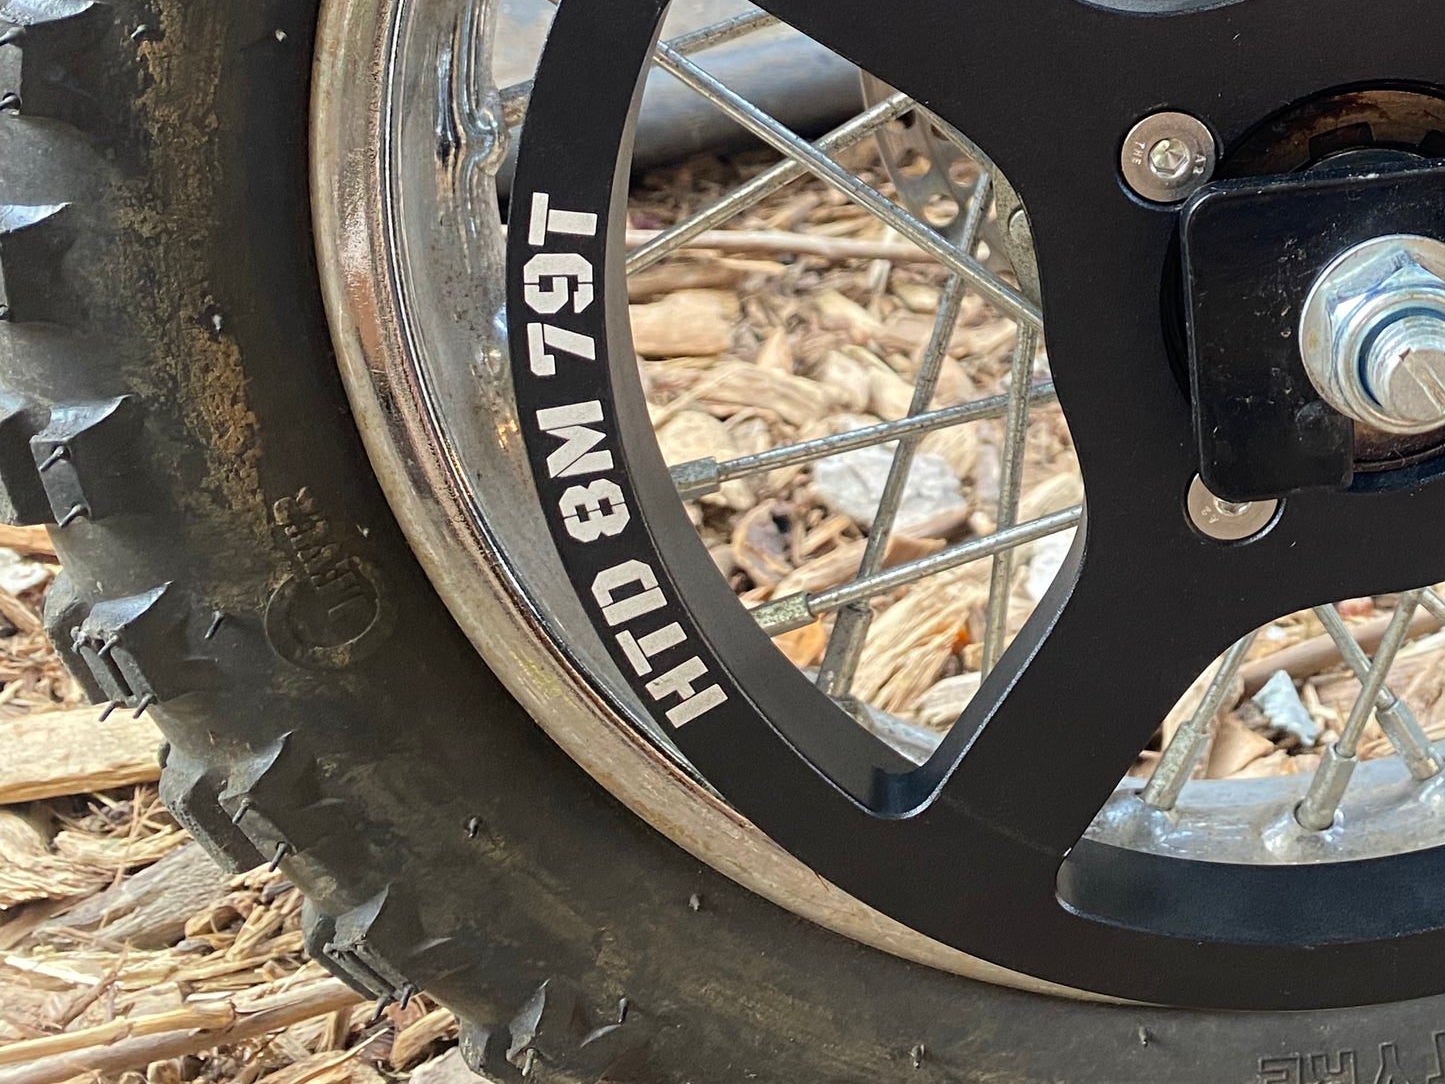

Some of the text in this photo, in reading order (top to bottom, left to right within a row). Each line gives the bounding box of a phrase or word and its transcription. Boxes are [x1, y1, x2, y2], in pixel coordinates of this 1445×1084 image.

[523, 191, 729, 729] HTD 8M 79T
